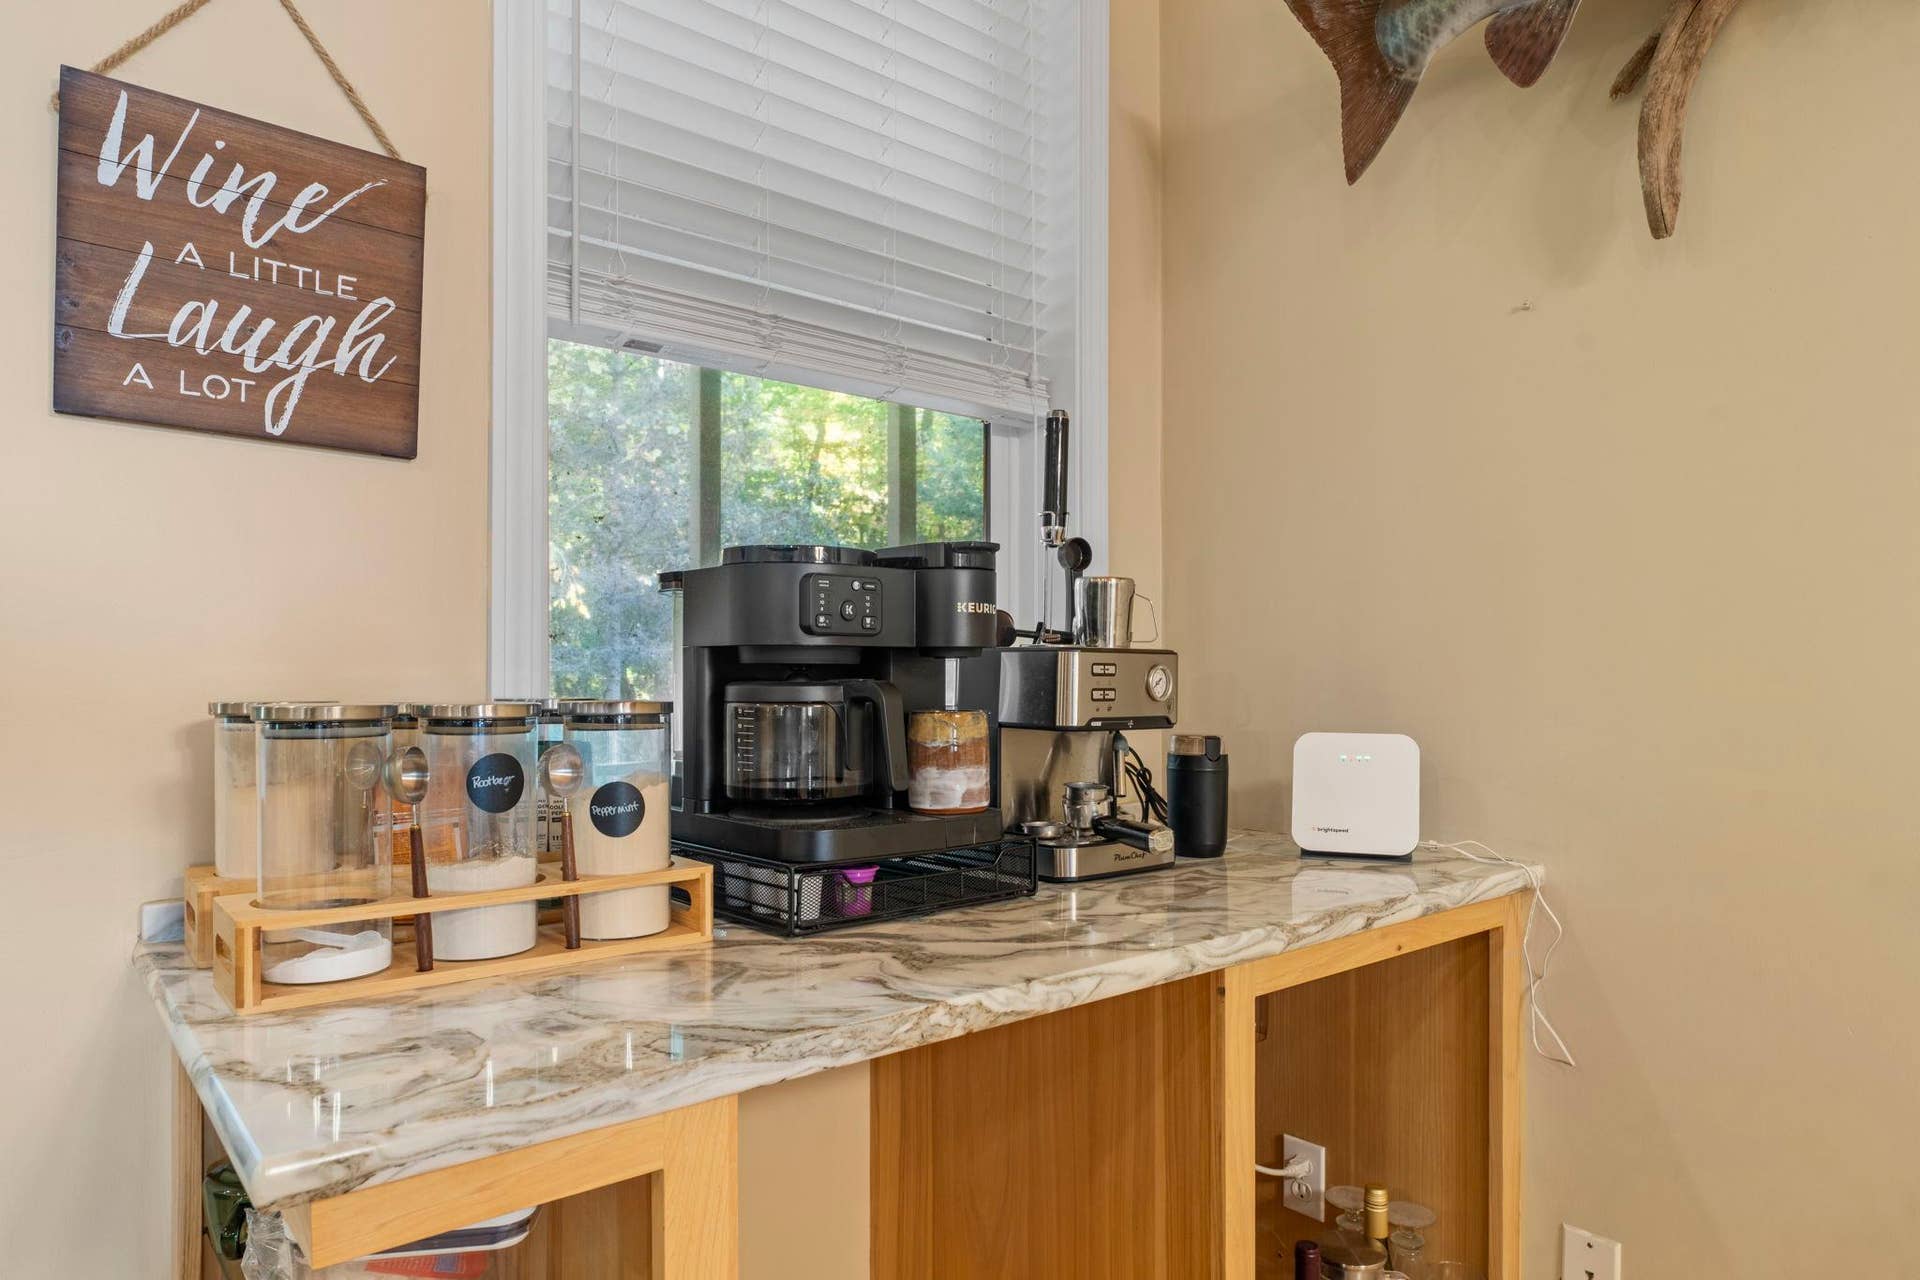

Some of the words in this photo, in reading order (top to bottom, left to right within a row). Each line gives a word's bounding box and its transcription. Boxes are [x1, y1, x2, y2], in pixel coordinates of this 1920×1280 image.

[97, 89, 389, 249] Wine
[174, 241, 206, 270] A
[228, 251, 359, 301] LITTLE
[107, 240, 398, 436] Laugh
[122, 362, 154, 390] A
[179, 369, 256, 403] LOT
